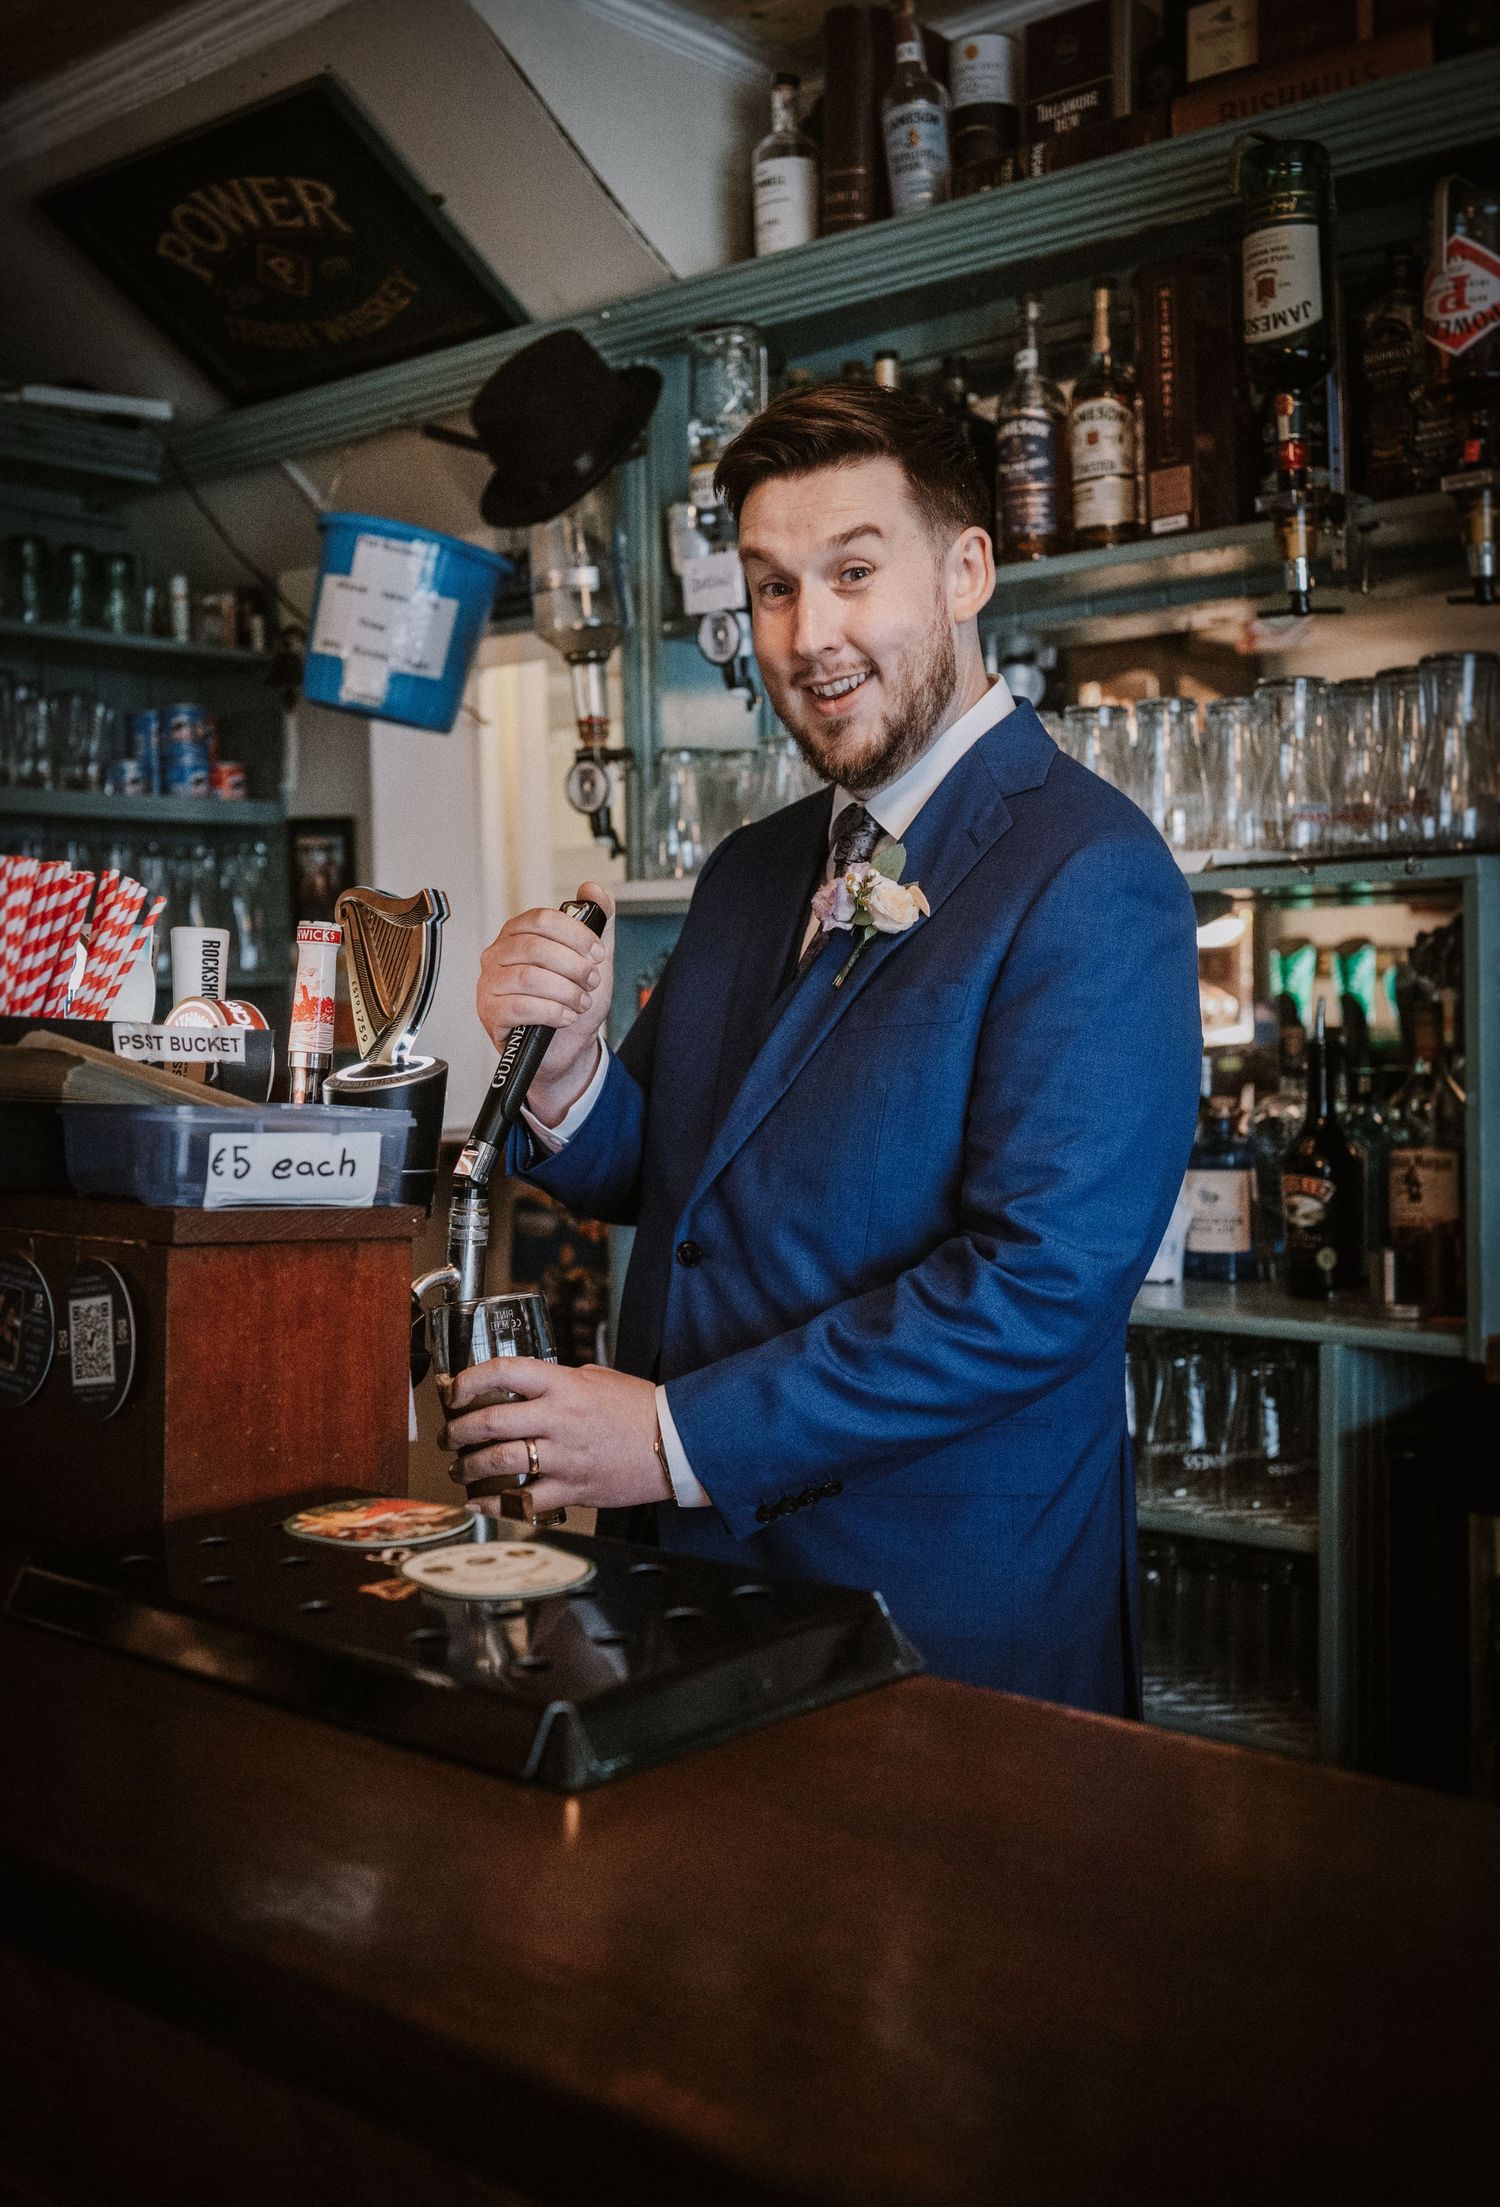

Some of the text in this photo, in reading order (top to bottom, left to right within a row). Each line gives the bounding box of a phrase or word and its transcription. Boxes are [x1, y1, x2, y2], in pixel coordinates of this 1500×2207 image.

[156, 175, 353, 286] POWER
[356, 1009, 368, 1042] 1759
[118, 1034, 241, 1053] PSST BUCKET
[211, 1145, 357, 1179] €5 each
